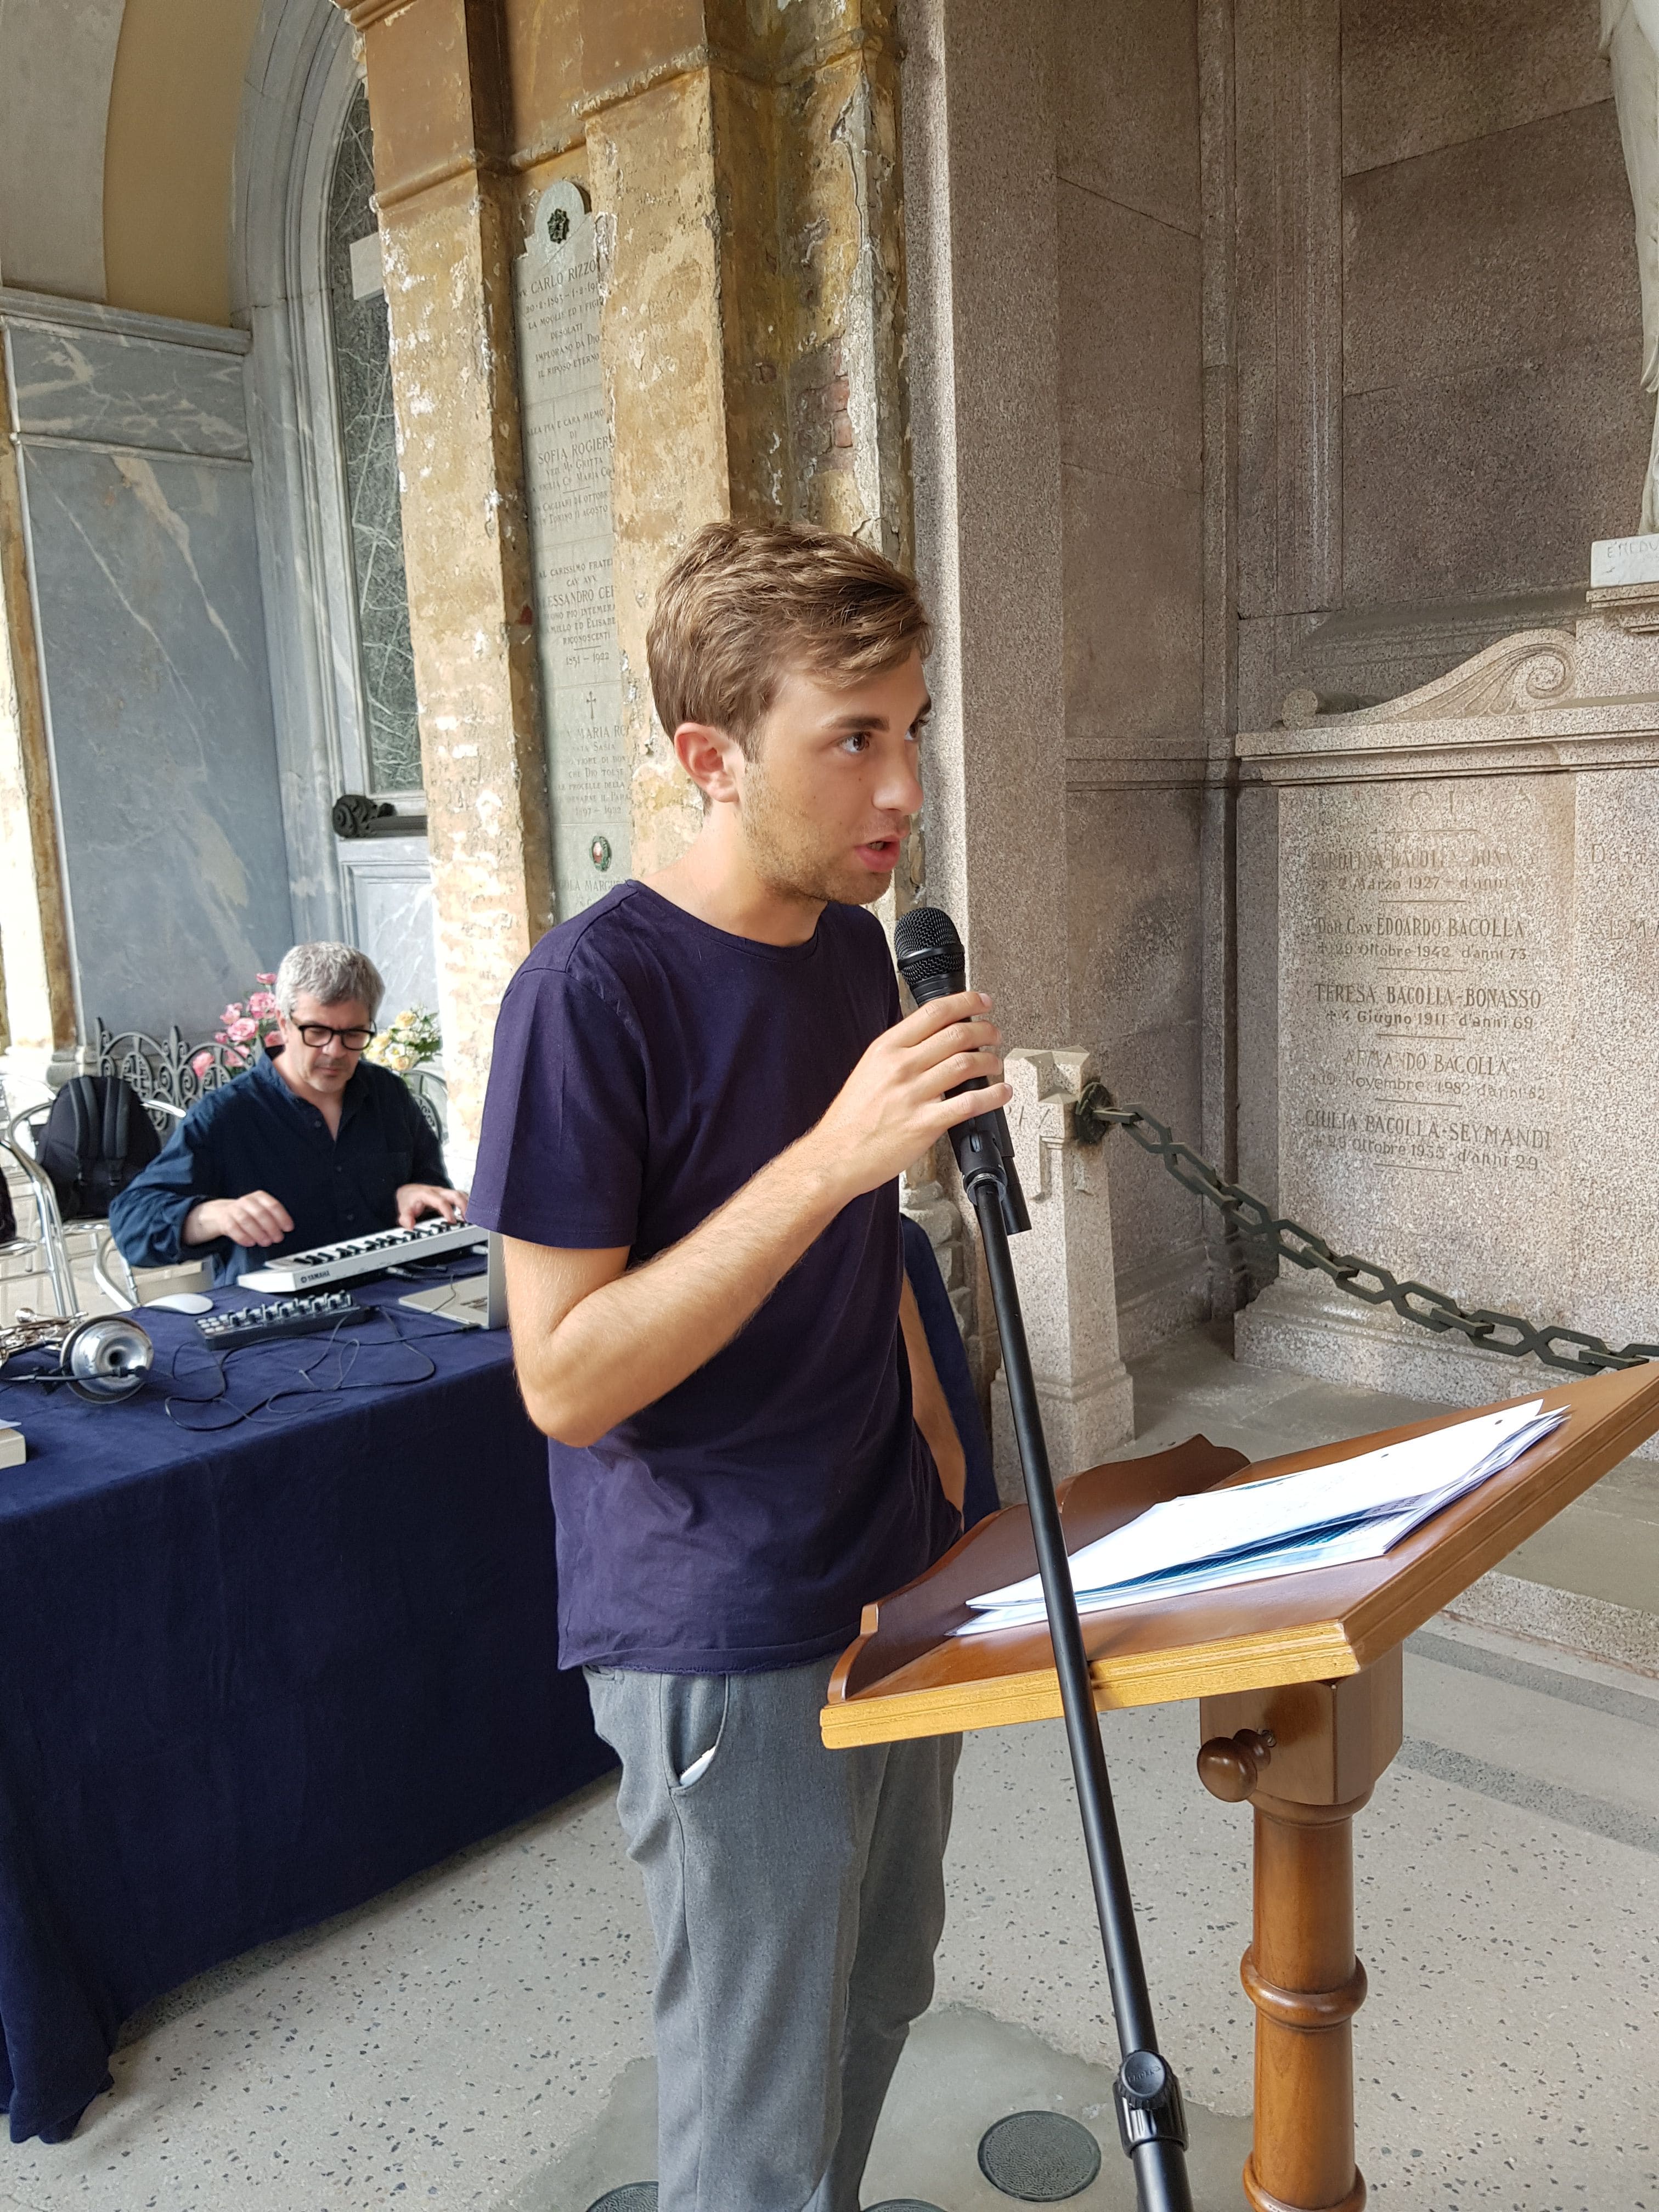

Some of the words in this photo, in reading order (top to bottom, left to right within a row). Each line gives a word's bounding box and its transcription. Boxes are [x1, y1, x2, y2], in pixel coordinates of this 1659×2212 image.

[531, 272, 563, 294] CARLO
[568, 259, 596, 283] RIZZO
[583, 408, 606, 421] MEMO
[538, 447, 568, 465] SOFIA
[572, 436, 610, 457] ROGIER
[578, 726, 610, 739] MARIA
[1377, 917, 1441, 936] EDOARDO
[1448, 917, 1524, 938] BACOLLA
[1418, 943, 1450, 958] 1942
[1510, 948, 1526, 961] 73
[1313, 983, 1375, 1003] TERESA
[1357, 1009, 1412, 1027] Giugno
[1513, 1015, 1533, 1029] 69
[1345, 1048, 1427, 1071] ARMANDO
[1434, 1053, 1509, 1076] BACOLLA
[1346, 1070, 1425, 1092] Novembre
[1305, 1109, 1357, 1132] GIULIA
[306, 1269, 331, 1282] YAMAHA
